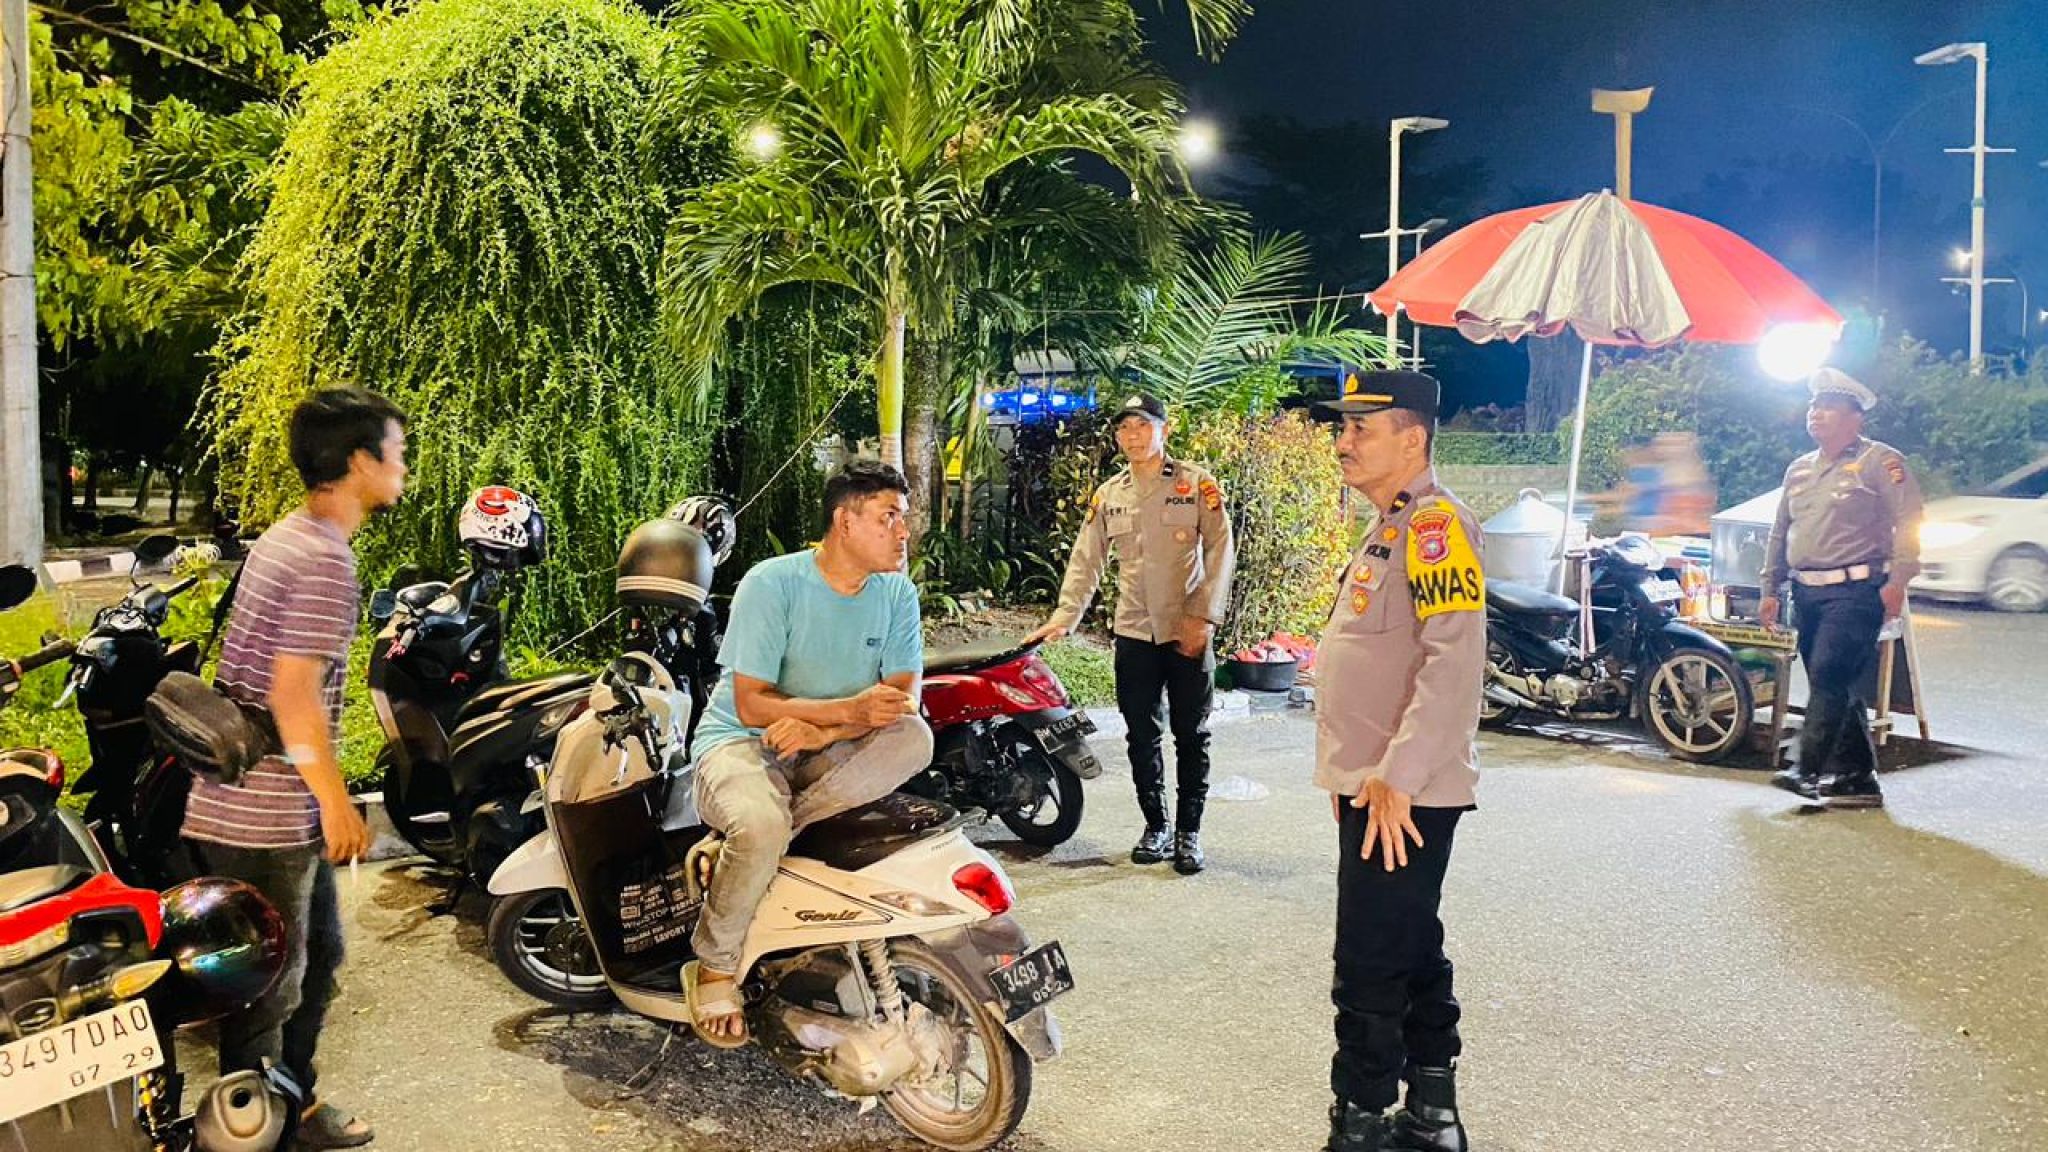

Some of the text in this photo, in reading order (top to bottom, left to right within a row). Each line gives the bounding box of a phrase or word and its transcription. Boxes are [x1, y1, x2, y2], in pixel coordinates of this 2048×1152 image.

[1003, 960, 1040, 993] 3498
[70, 1046, 154, 1087] 07 29
